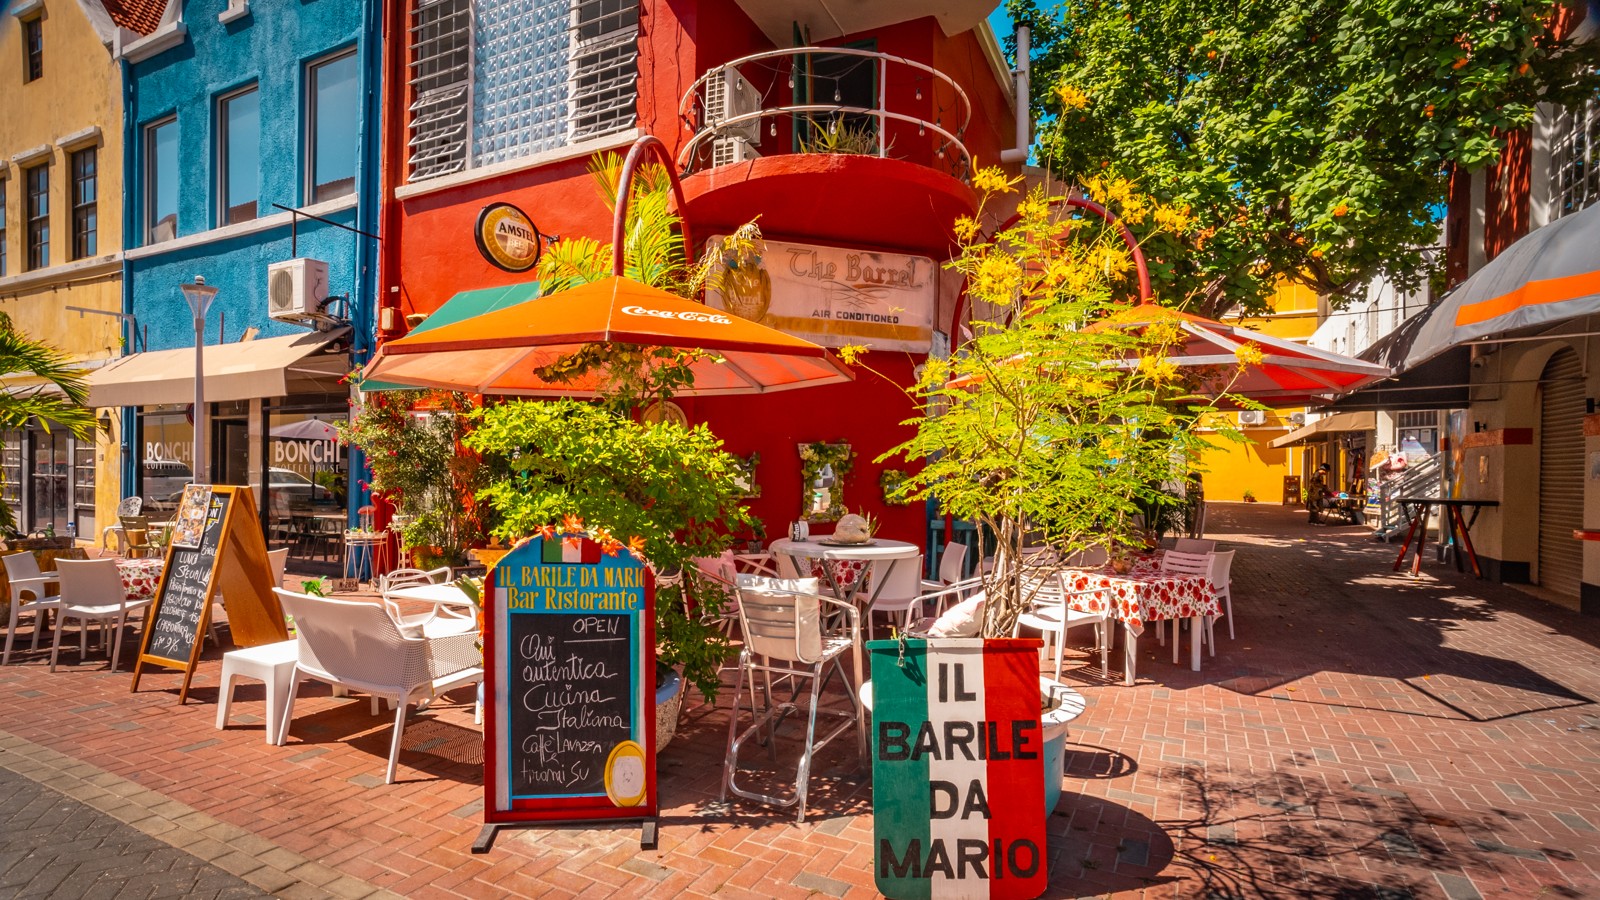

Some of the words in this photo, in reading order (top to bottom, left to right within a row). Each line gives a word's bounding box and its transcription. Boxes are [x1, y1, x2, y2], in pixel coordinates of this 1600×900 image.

[498, 222, 534, 242] AMSTEL
[787, 248, 837, 281] The
[846, 253, 922, 288] Barrel
[812, 309, 831, 319] AIR
[836, 310, 899, 324] CONDITIONED
[146, 441, 194, 462] BONCHI
[274, 440, 340, 463] BONCHI
[274, 463, 340, 473] COFFEEHOUSE
[500, 566, 515, 587] IL
[521, 566, 576, 587] BARILE
[580, 566, 598, 587] DA
[508, 587, 539, 610] Bar
[545, 587, 637, 611] Ristorante
[572, 616, 620, 635] OPEN
[520, 633, 556, 661] Qui
[522, 652, 619, 683] autentica
[938, 662, 977, 703] IL
[523, 683, 617, 712] Cucina
[536, 704, 631, 731] Italiana
[878, 720, 1038, 761] BARILE
[930, 779, 993, 820] DA
[880, 838, 1040, 880] MARIO
